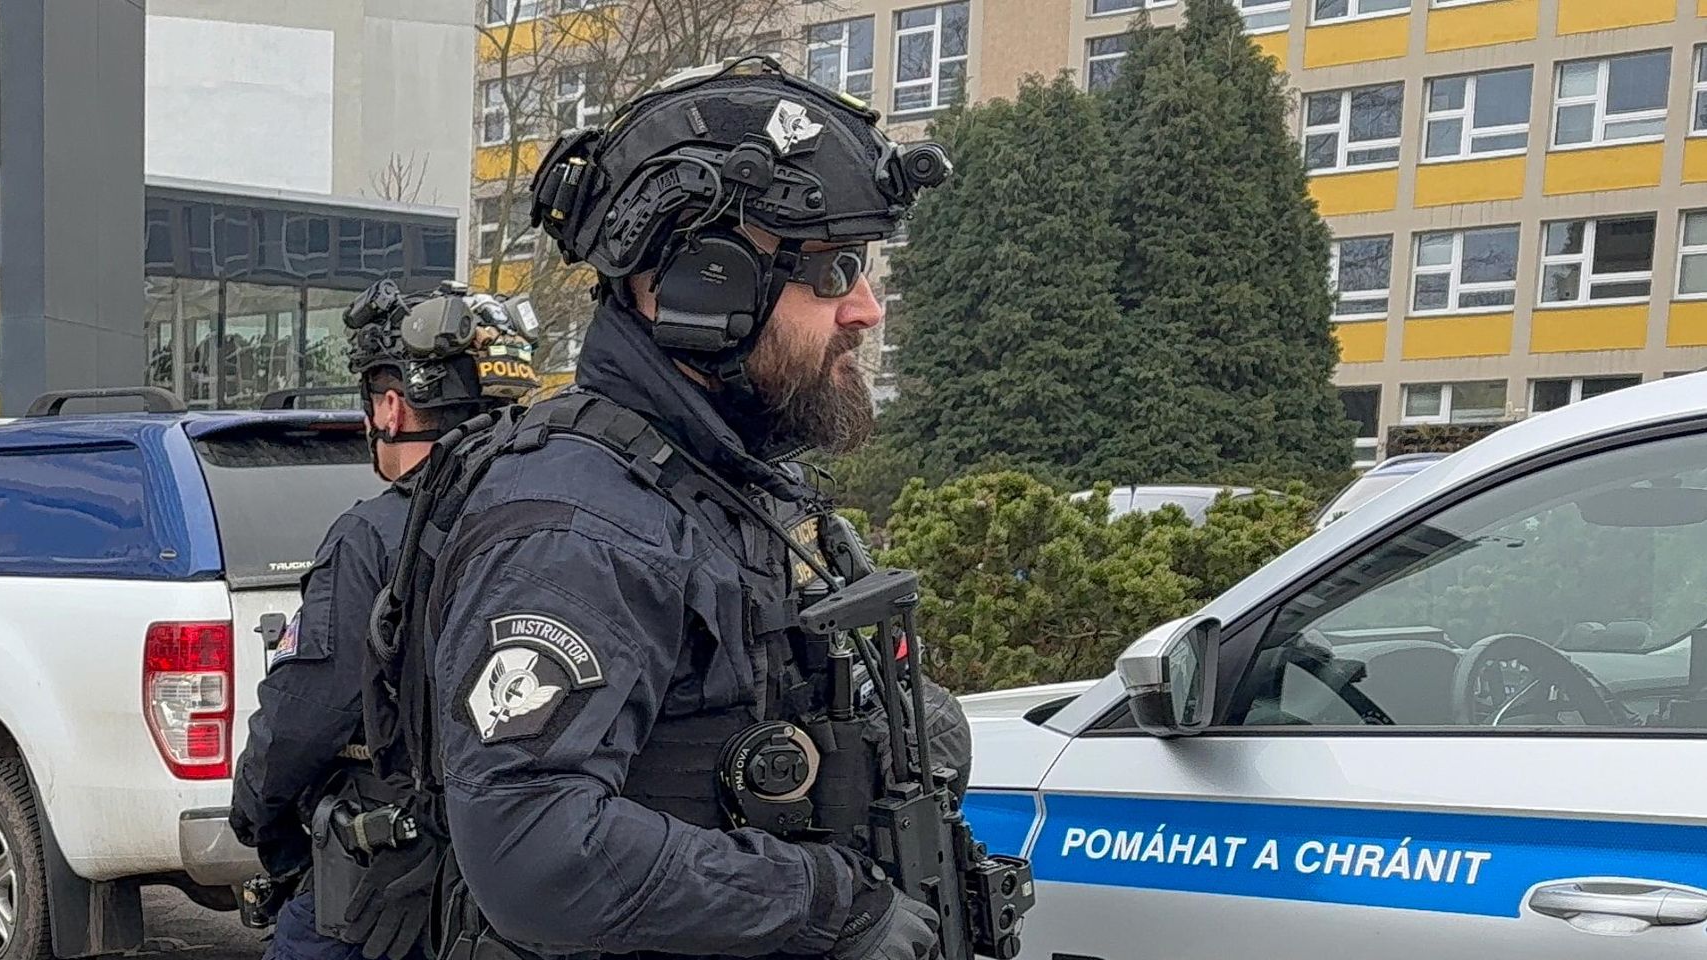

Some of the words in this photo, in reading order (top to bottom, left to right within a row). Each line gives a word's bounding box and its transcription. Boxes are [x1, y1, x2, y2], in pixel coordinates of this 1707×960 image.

[269, 560, 315, 571] TRUCKM
[511, 620, 589, 665] INSTRUKTOR
[736, 747, 751, 769] OVA
[1061, 823, 1247, 868] POMÁHAT
[1252, 839, 1280, 871] A
[1294, 836, 1492, 885] CHRÁNIT
